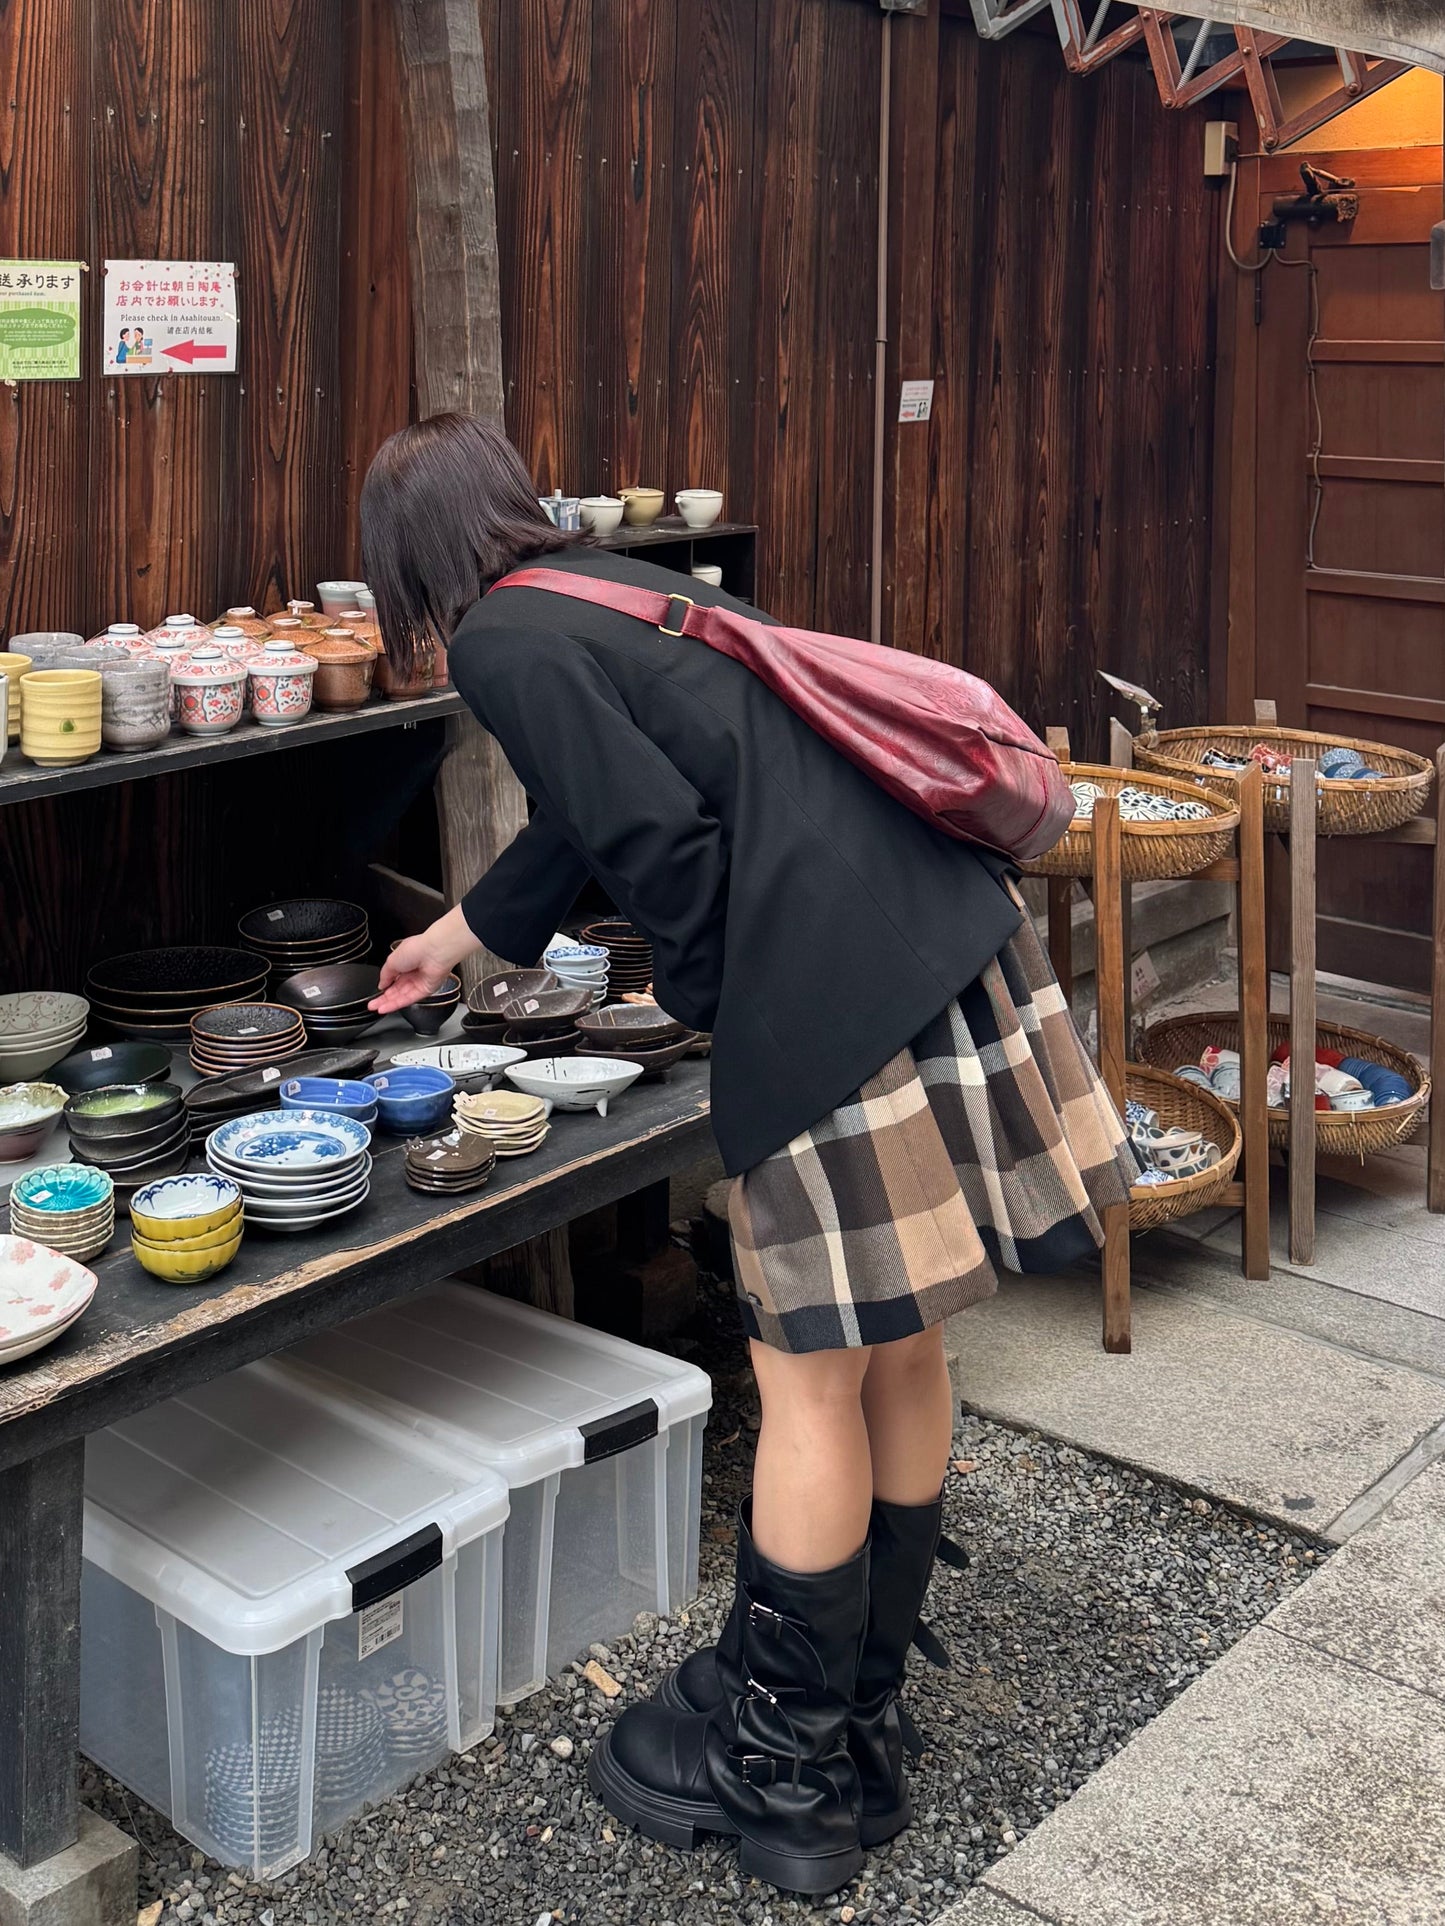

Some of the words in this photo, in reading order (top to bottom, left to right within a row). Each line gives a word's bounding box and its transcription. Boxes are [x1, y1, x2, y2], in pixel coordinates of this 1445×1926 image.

[116, 295, 224, 307] 店内でお願いします。
[120, 314, 145, 322] Please
[147, 314, 168, 322] check
[171, 314, 178, 322] in
[180, 314, 223, 322] Asahitouan.
